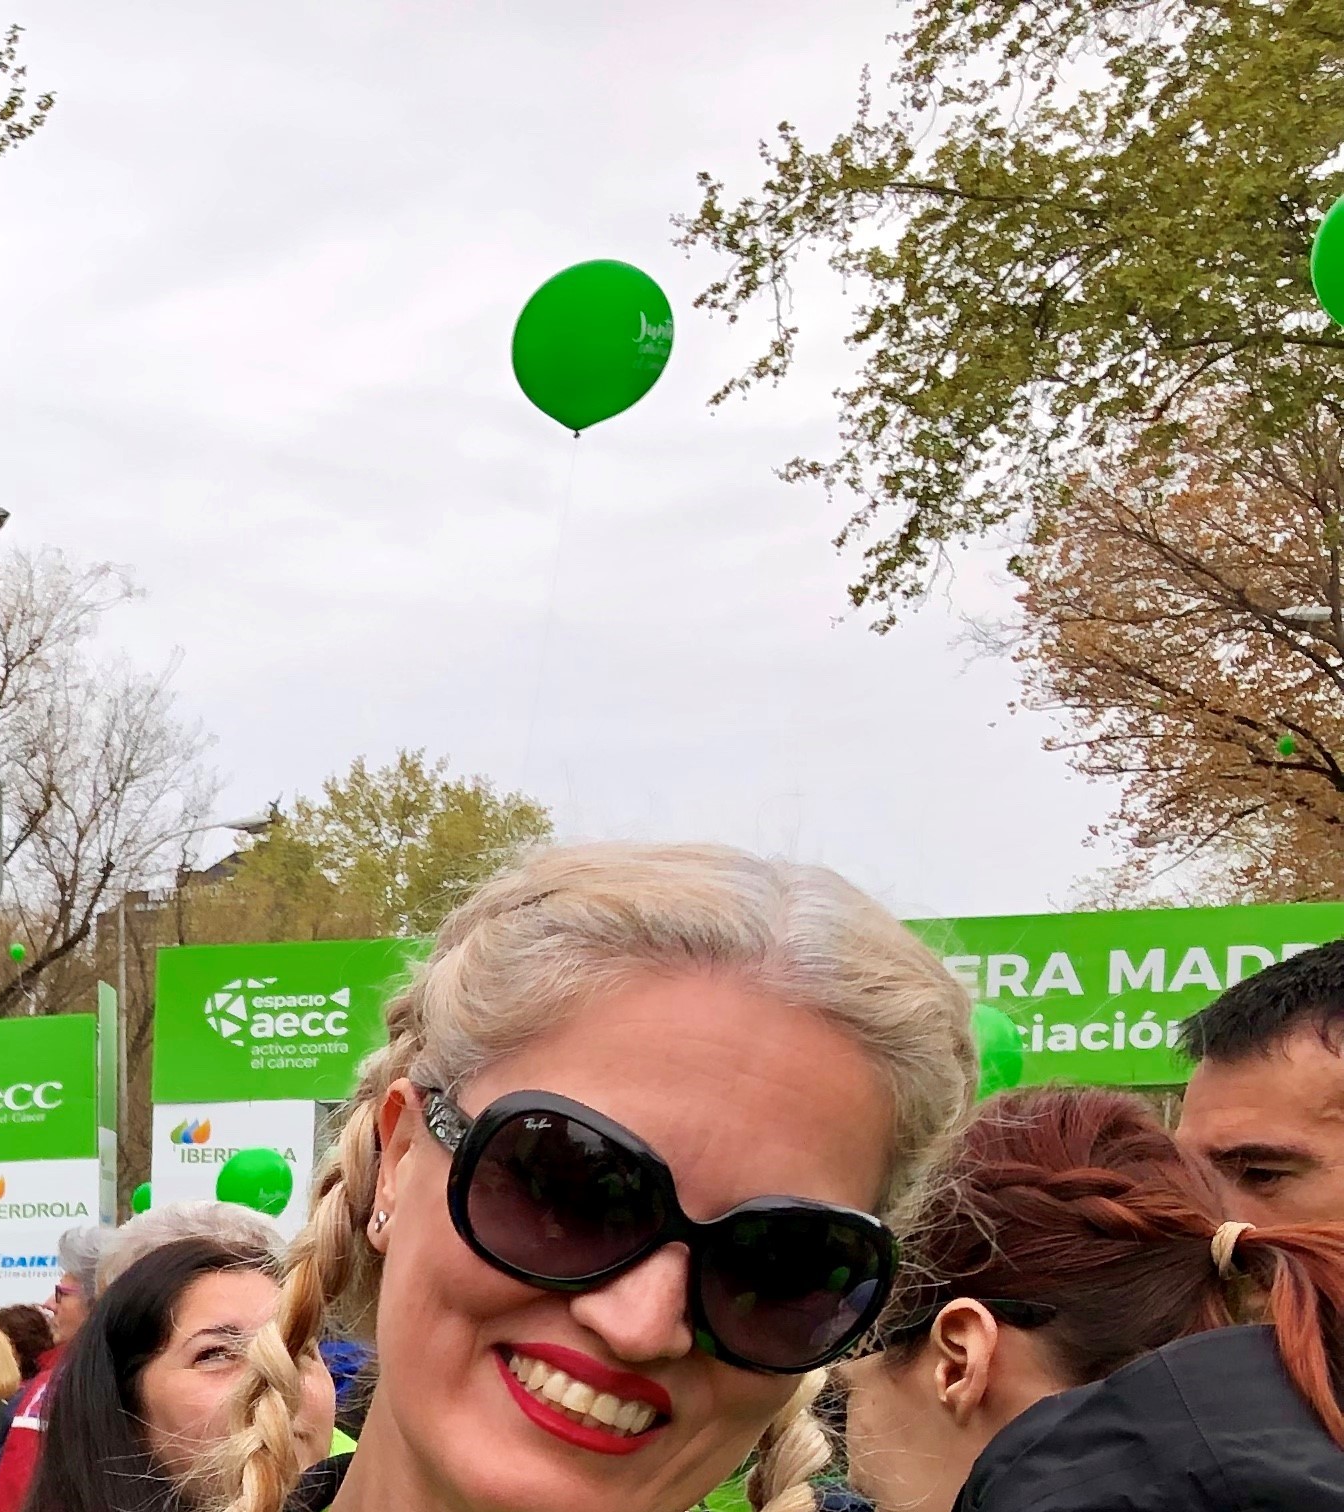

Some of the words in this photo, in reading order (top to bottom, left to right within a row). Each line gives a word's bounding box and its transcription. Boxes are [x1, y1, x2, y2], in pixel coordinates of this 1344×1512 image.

[1108, 942, 1320, 994] MAD
[252, 993, 326, 1011] espacio
[250, 1010, 349, 1039] aecc
[251, 1043, 297, 1056] activo
[300, 1041, 349, 1055] contra
[251, 1057, 264, 1070] el
[267, 1056, 319, 1070] cáncer
